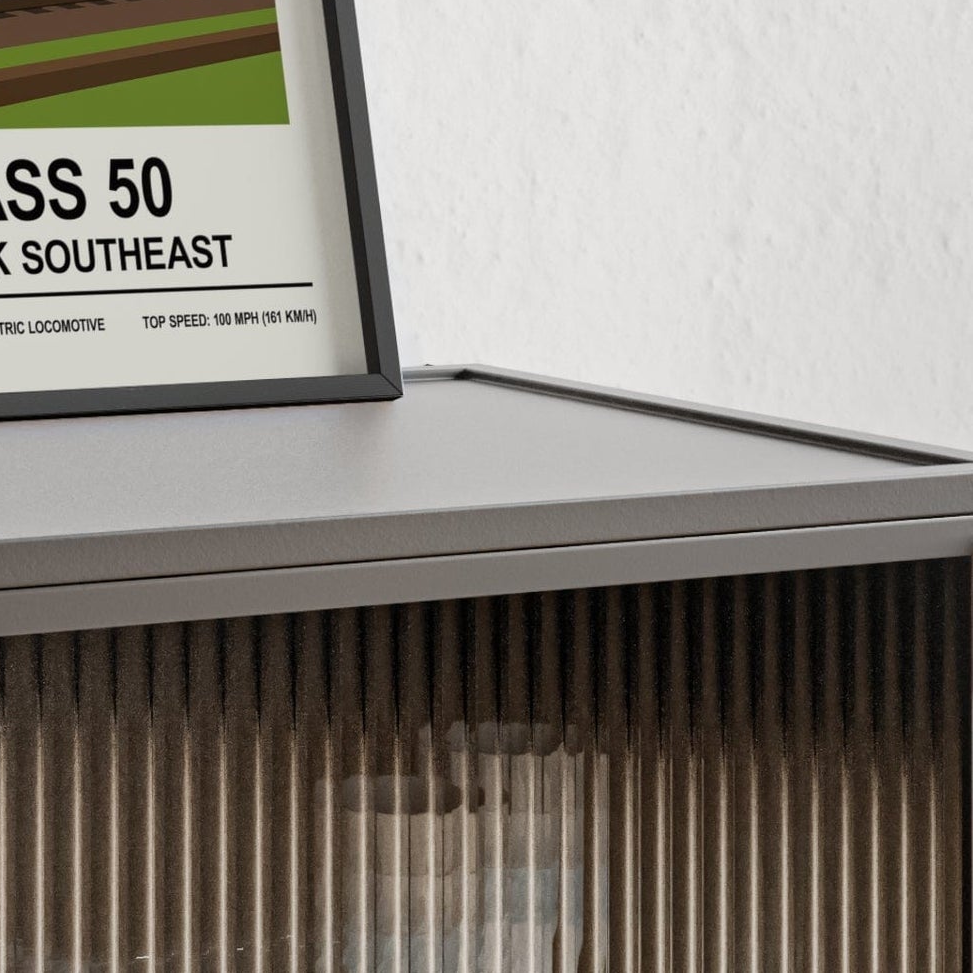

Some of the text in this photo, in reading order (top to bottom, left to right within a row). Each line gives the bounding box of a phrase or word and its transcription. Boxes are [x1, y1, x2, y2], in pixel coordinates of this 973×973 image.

[108, 156, 173, 219] 50
[21, 234, 233, 275] SOUTHEAST
[27, 317, 106, 334] LOCOMOTIVE
[142, 309, 317, 329] TOP SPEED: 100 MPH (161 KM/H)
